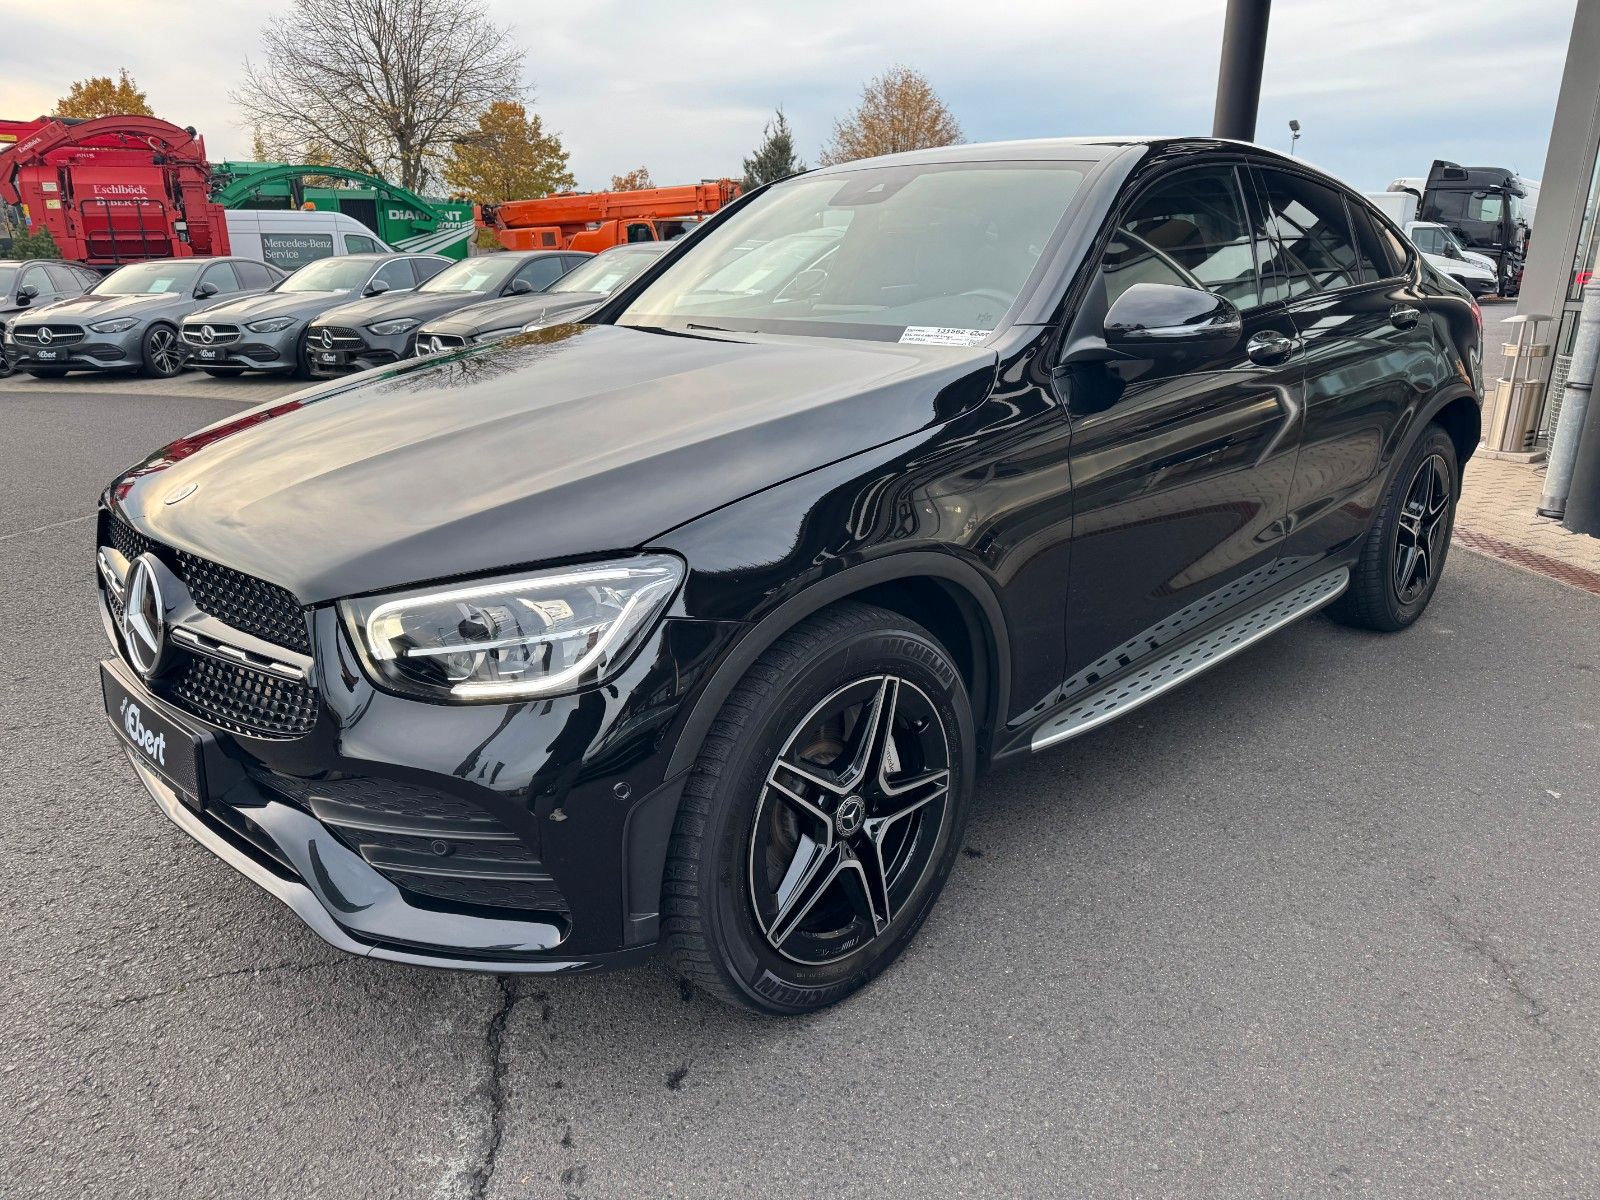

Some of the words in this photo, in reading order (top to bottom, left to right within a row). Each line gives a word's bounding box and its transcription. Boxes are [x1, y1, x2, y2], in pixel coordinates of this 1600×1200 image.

[93, 185, 147, 195] Eschlböck
[264, 238, 332, 248] Mercedes-Benz
[265, 249, 299, 259] Service
[38, 350, 57, 358] Ebert
[879, 638, 955, 684] MICHELIN
[124, 703, 166, 767] Ebert
